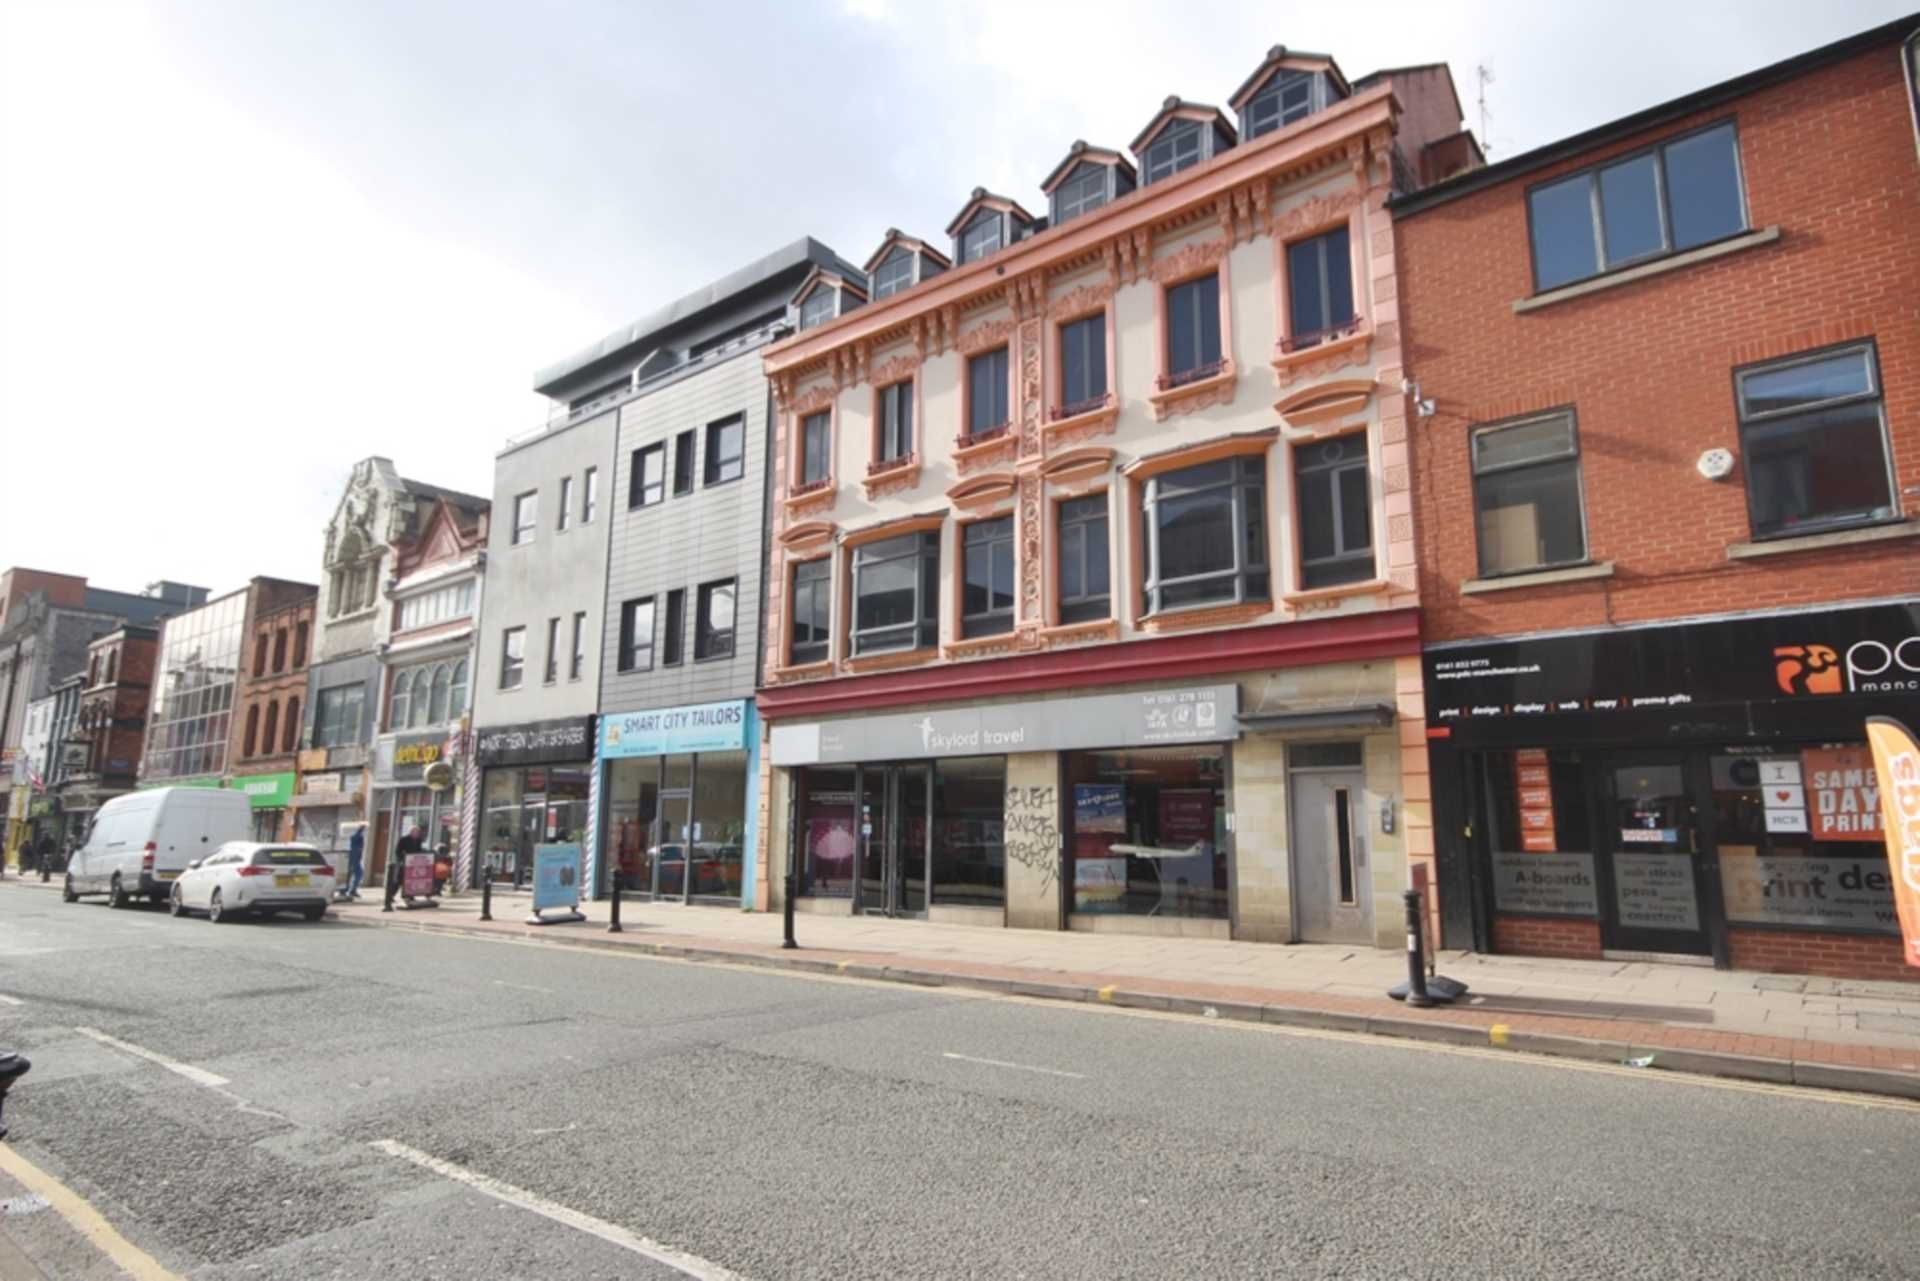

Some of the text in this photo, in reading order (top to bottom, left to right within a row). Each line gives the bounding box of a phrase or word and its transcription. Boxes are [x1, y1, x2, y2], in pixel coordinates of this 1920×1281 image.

[1439, 694, 1691, 718] print design display web copy promo gifts
[624, 706, 742, 734] SMART CITY TAILORS
[983, 727, 1024, 744] travel
[1775, 766, 1785, 779] I
[1813, 768, 1875, 788] SAME
[1818, 788, 1879, 814] DAY
[1772, 816, 1800, 825] MCR
[1514, 870, 1592, 886] A-boards
[1737, 871, 1827, 902] print
